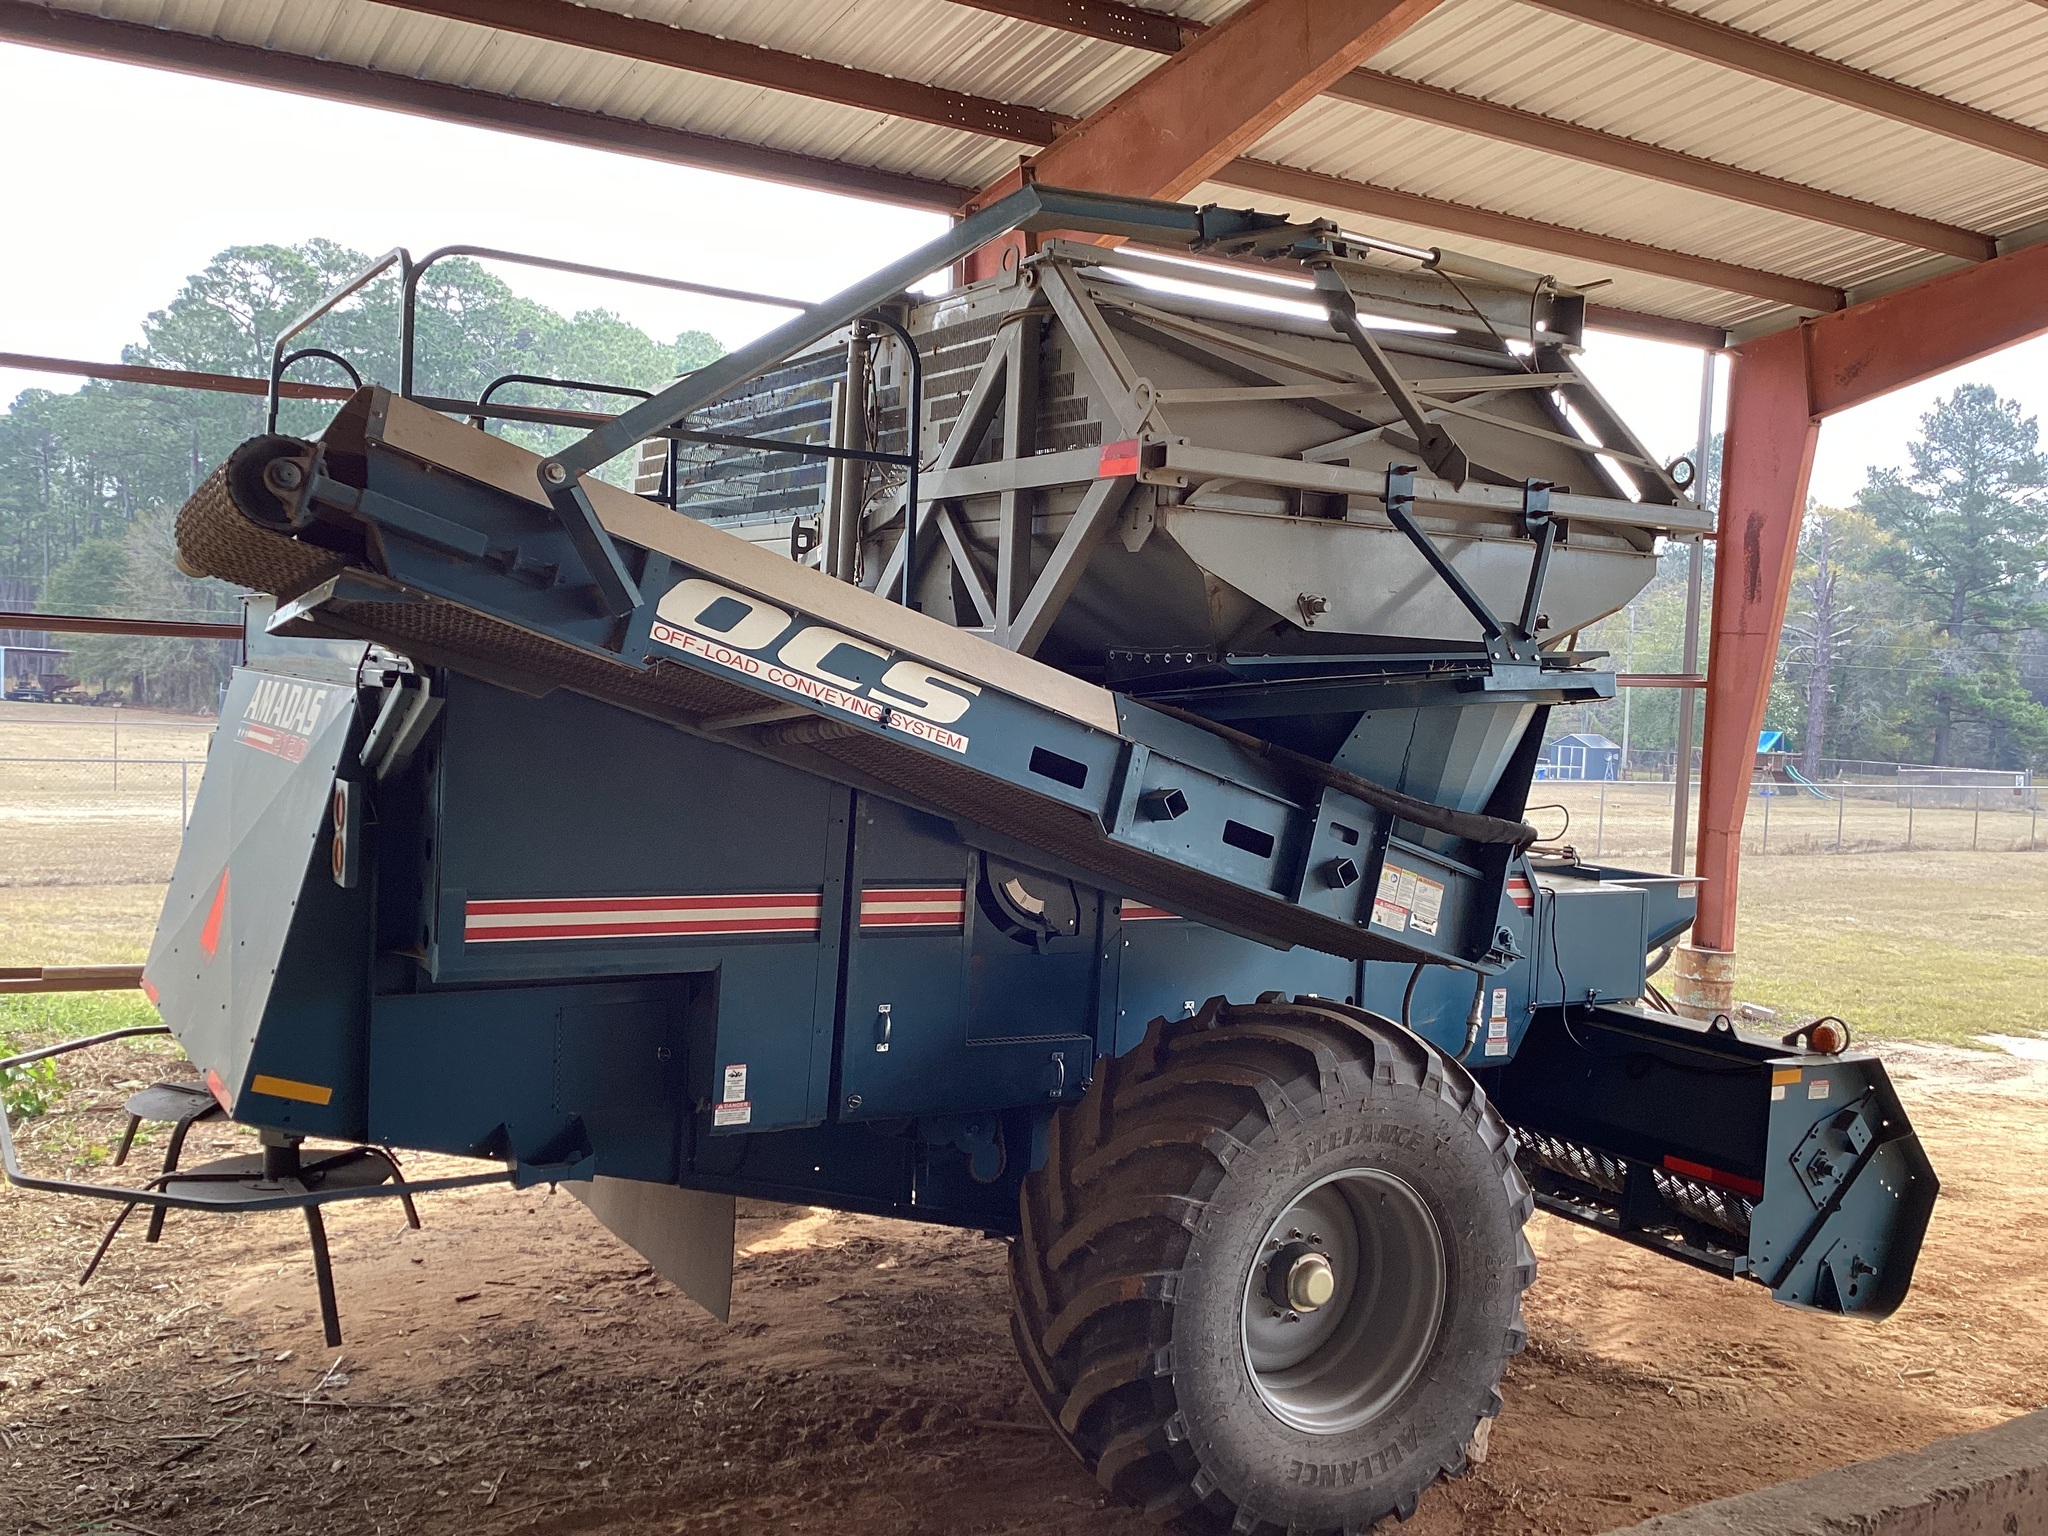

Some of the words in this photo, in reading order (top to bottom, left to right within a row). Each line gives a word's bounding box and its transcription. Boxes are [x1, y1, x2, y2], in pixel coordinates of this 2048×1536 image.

[656, 579, 982, 724] OCS
[243, 679, 328, 736] AMADAS
[654, 626, 760, 674] OFF-LOAD
[768, 667, 882, 719] CONVEYING
[890, 712, 963, 751] SYSTEM
[724, 1101, 749, 1109] DANGER
[1293, 1123, 1426, 1177] ALLIANCE
[1482, 1254, 1502, 1319] 360
[1286, 1423, 1419, 1488] ALLIANCE
